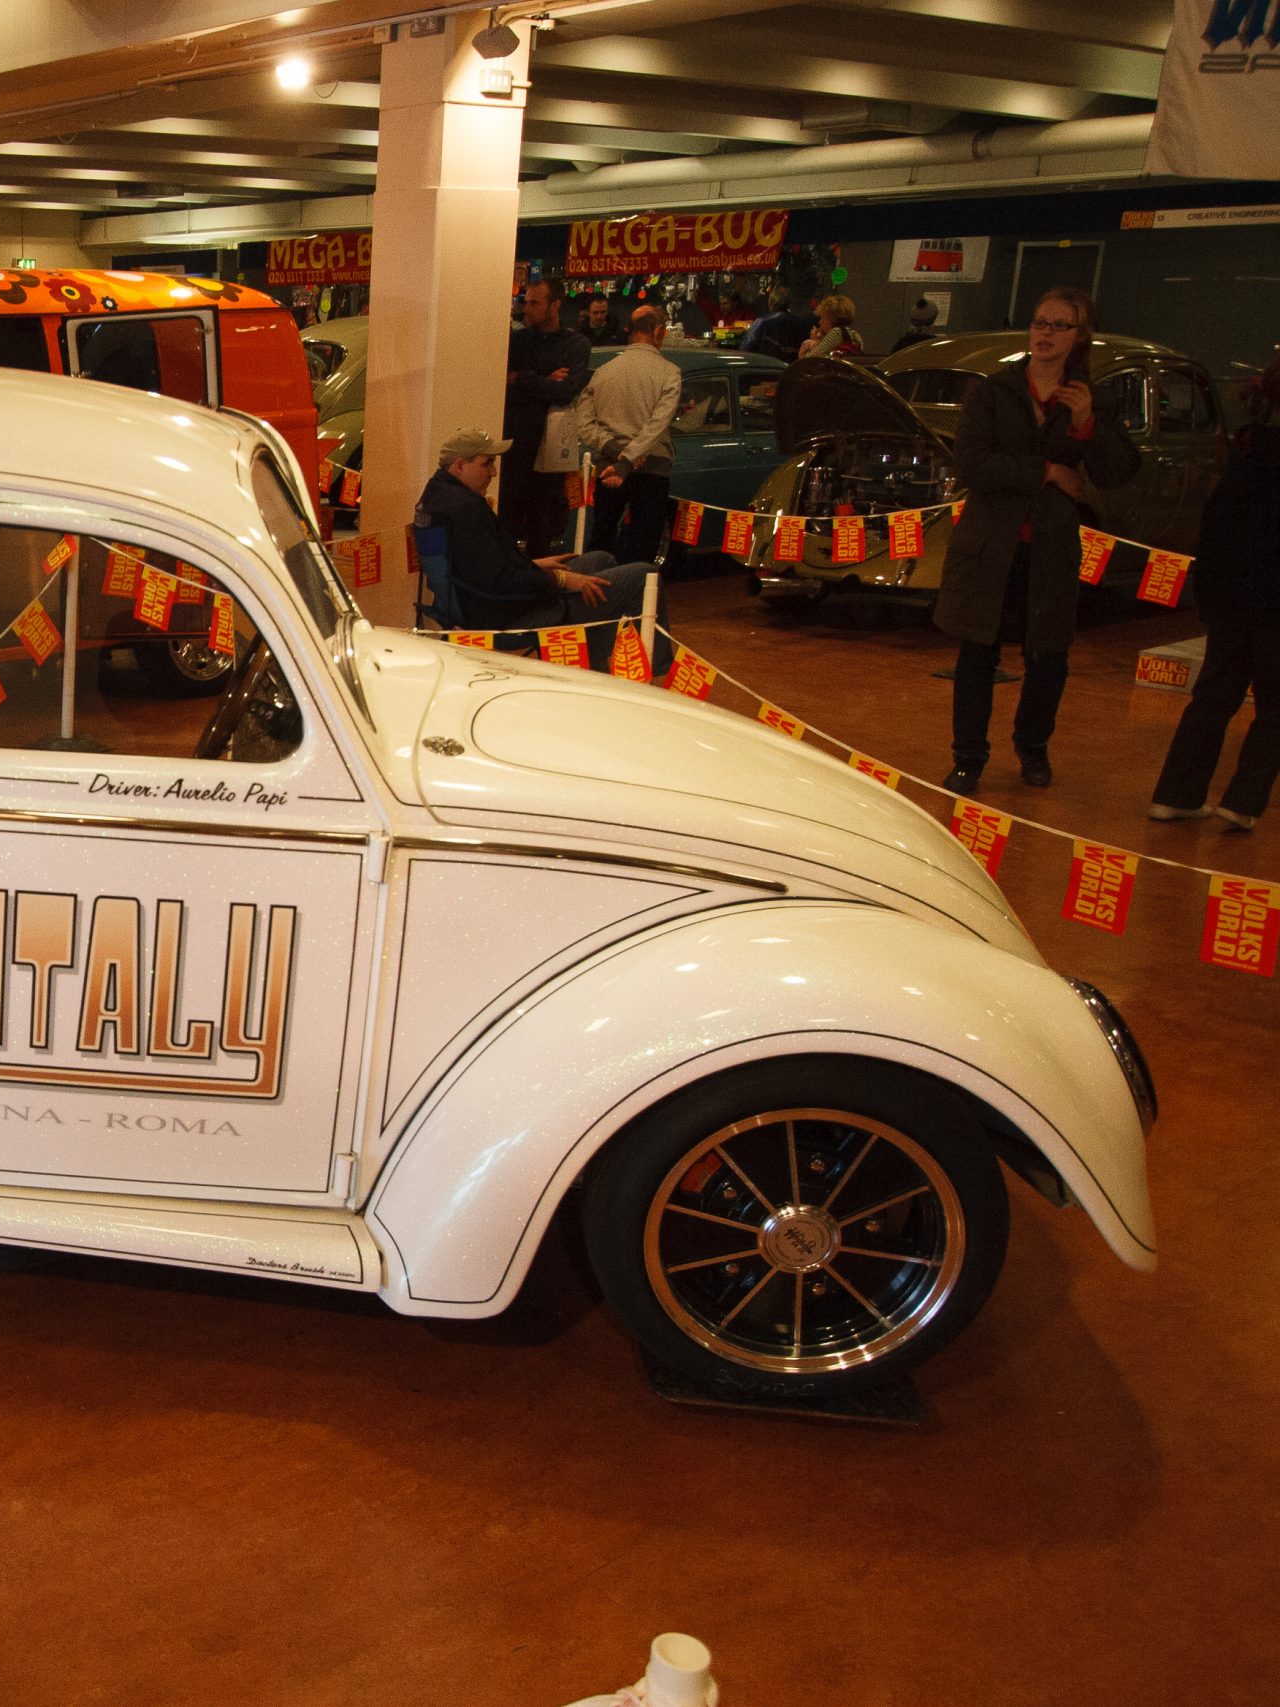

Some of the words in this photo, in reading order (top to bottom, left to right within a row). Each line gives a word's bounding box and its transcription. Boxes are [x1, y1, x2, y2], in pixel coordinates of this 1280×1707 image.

[570, 209, 784, 257] MEGA-BUG
[1187, 211, 1228, 221] CREATIVE
[270, 233, 372, 270] MEGA-B
[570, 258, 589, 273] 020
[658, 252, 777, 269] www.megabug.co.uk
[268, 272, 285, 284] 020
[727, 511, 740, 550] WORLD
[734, 512, 748, 557] VOLKS
[779, 518, 791, 557] WORLD
[788, 518, 800, 557] VOLKS
[837, 518, 848, 557] WORLD
[847, 518, 859, 557] VOLKS
[895, 513, 907, 553] WORLD
[905, 512, 918, 553] VOLKS
[1082, 535, 1109, 578] VOLKS
[1144, 553, 1170, 597] WORLD
[140, 569, 161, 618] WORLD
[1157, 556, 1183, 600] VOLKS
[150, 575, 172, 629] VOLKS
[215, 597, 233, 647] WORLD
[24, 604, 56, 649] VOLKS
[545, 630, 564, 665] WOR
[561, 629, 582, 669] VOL
[1141, 655, 1190, 675] VOLKS
[669, 652, 697, 695] WOR
[687, 661, 712, 697] VOL
[1138, 667, 1188, 685] WORLD
[88, 773, 158, 798] Driver:
[163, 777, 236, 802] Aurelio
[242, 782, 288, 811] Papi
[958, 804, 982, 850] WOR
[972, 813, 1001, 871] VOLK
[1074, 845, 1105, 915] WORLD
[1094, 852, 1127, 925] VOLKS
[1212, 880, 1246, 959] WORLD
[1236, 887, 1271, 965] VOLKS
[106, 1112, 241, 1137] ROMA
